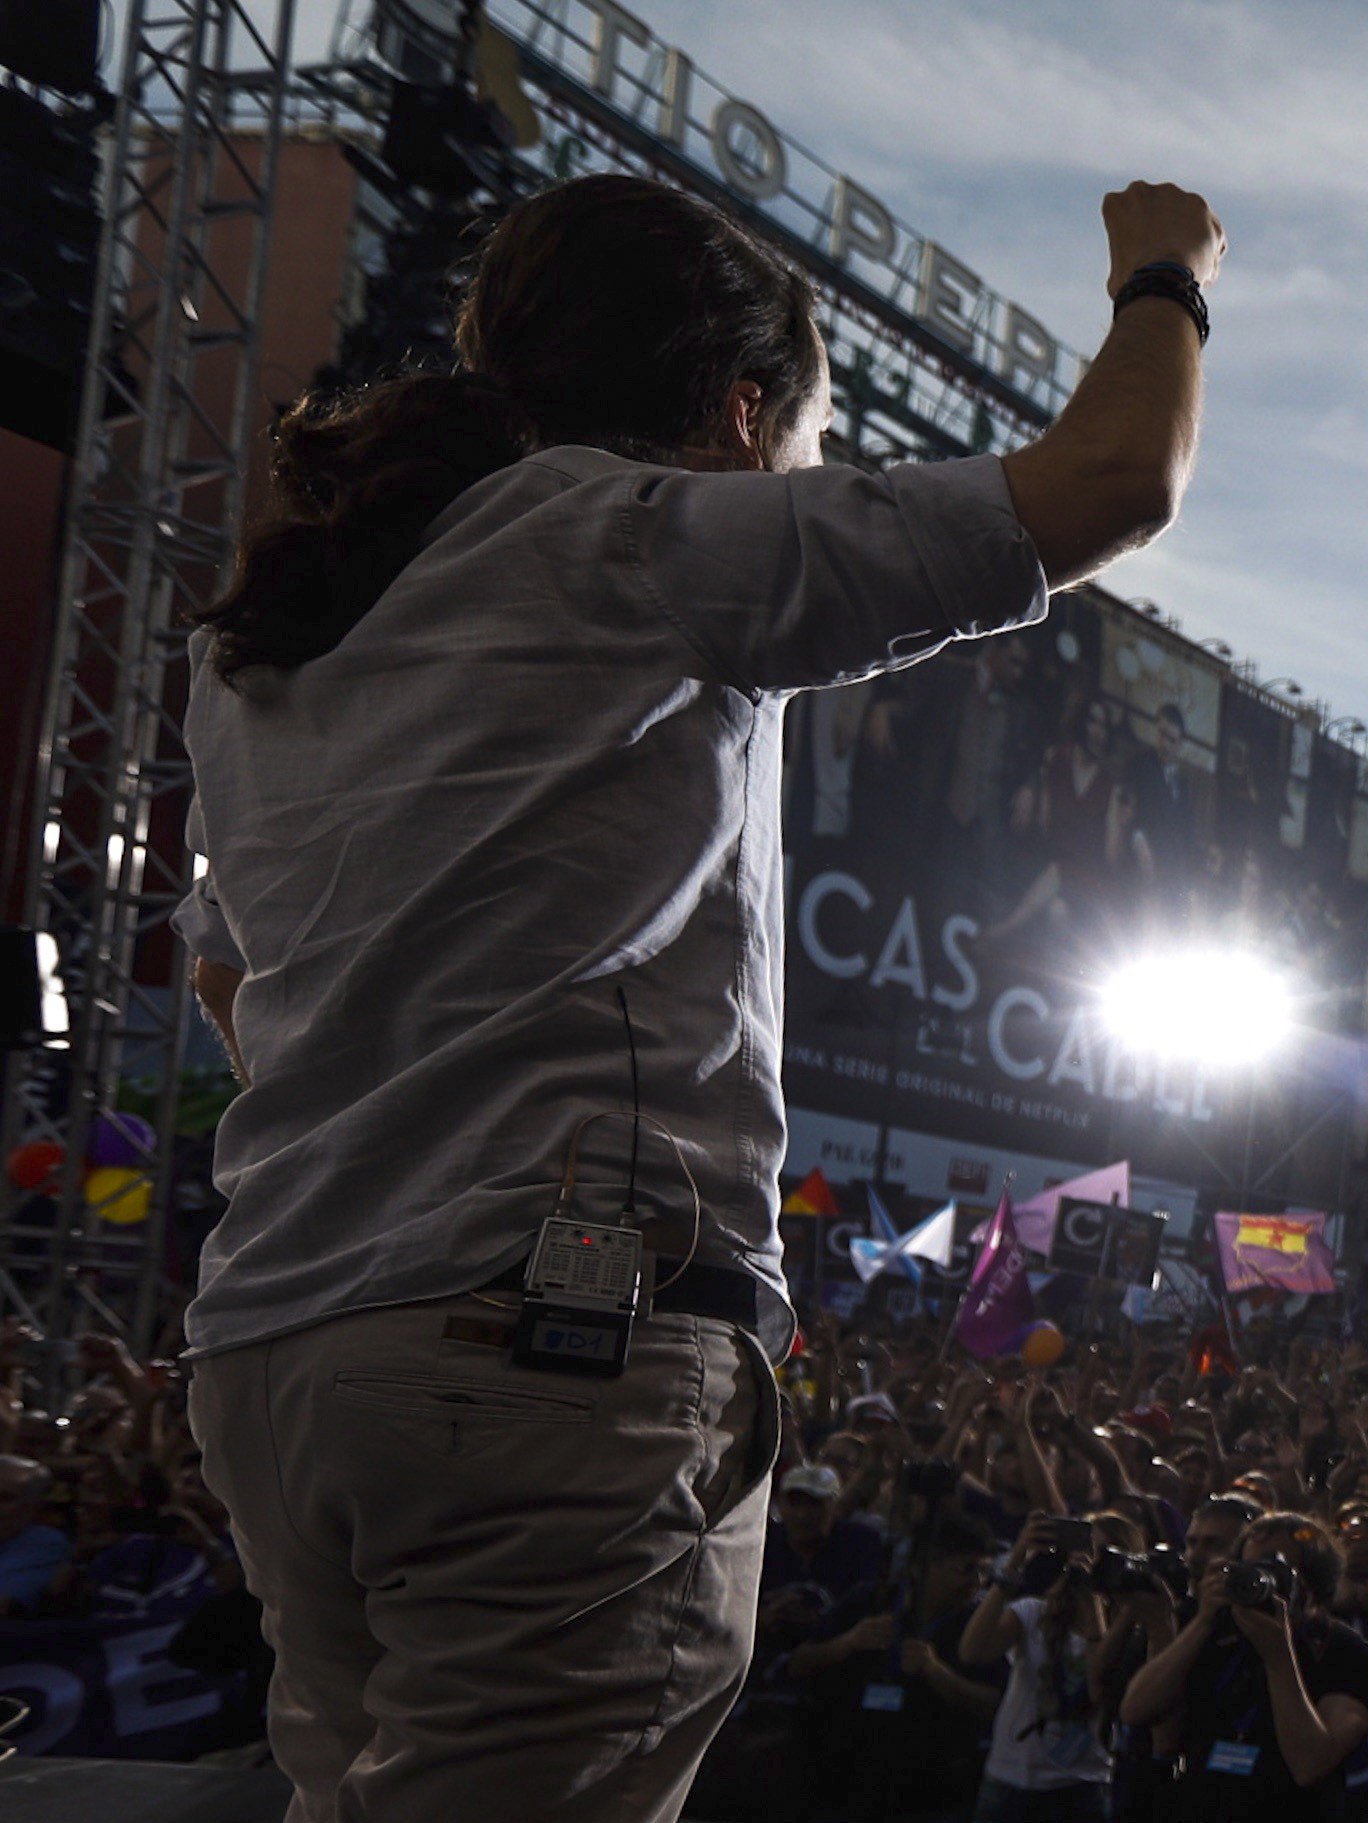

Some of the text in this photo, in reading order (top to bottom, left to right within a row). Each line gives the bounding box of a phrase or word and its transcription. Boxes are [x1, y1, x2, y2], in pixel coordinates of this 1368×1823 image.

[579, 0, 1088, 386] TIO PEP
[832, 1055, 888, 1082] SERIE
[895, 1070, 984, 1107] ORIGINAL
[990, 1092, 1014, 1112] DE
[1018, 1099, 1090, 1128] NETFLIX
